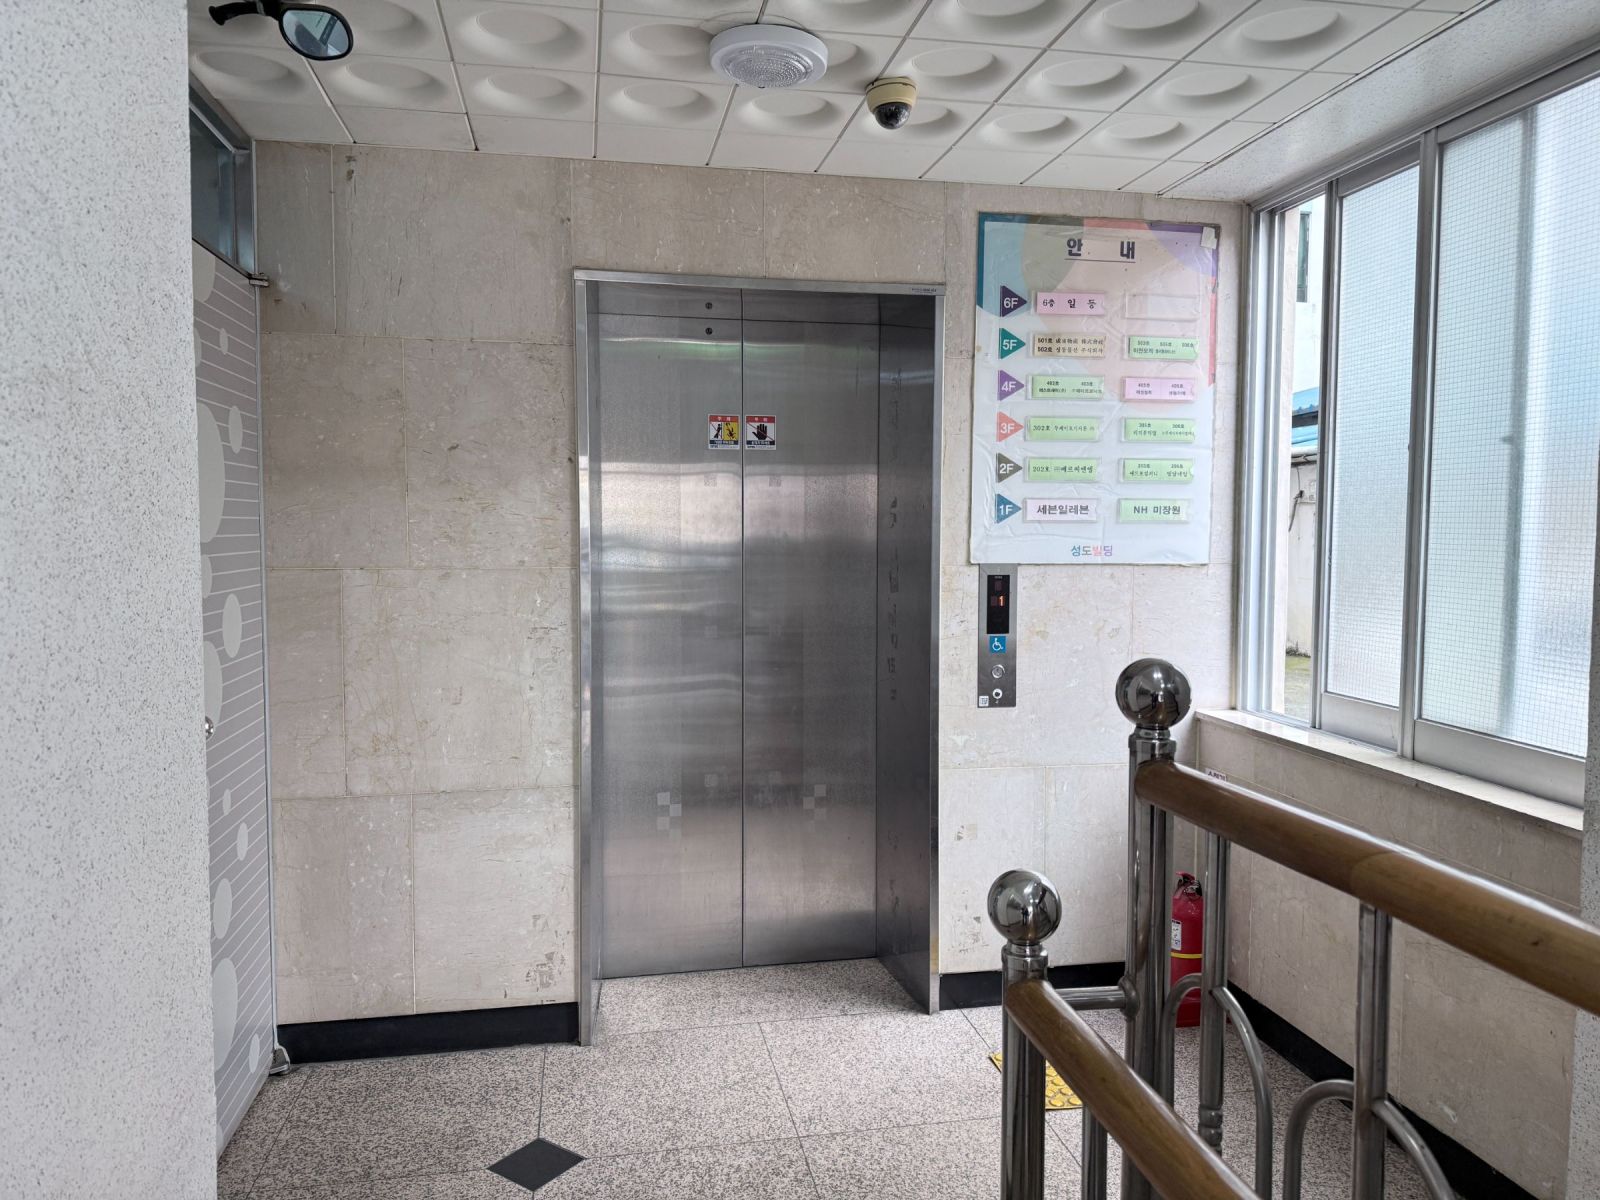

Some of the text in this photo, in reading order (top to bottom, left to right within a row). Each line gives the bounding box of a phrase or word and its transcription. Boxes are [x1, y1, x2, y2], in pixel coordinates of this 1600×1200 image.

[1066, 238, 1136, 260] 안 내
[1003, 297, 1019, 308] 6F
[1042, 299, 1055, 308] 6층
[1067, 298, 1076, 309] 일
[1002, 339, 1017, 350] 5F
[1001, 381, 1016, 392] 4F
[1000, 422, 1014, 433] 3F
[999, 463, 1014, 474] 2F
[1032, 464, 1050, 473] 202호
[999, 504, 1013, 515] 1F
[1036, 504, 1090, 515] 세븐일레븐
[1133, 505, 1181, 515] NH 미장원
[1071, 545, 1113, 557] 성도빌딩
[999, 595, 1004, 607] 1
